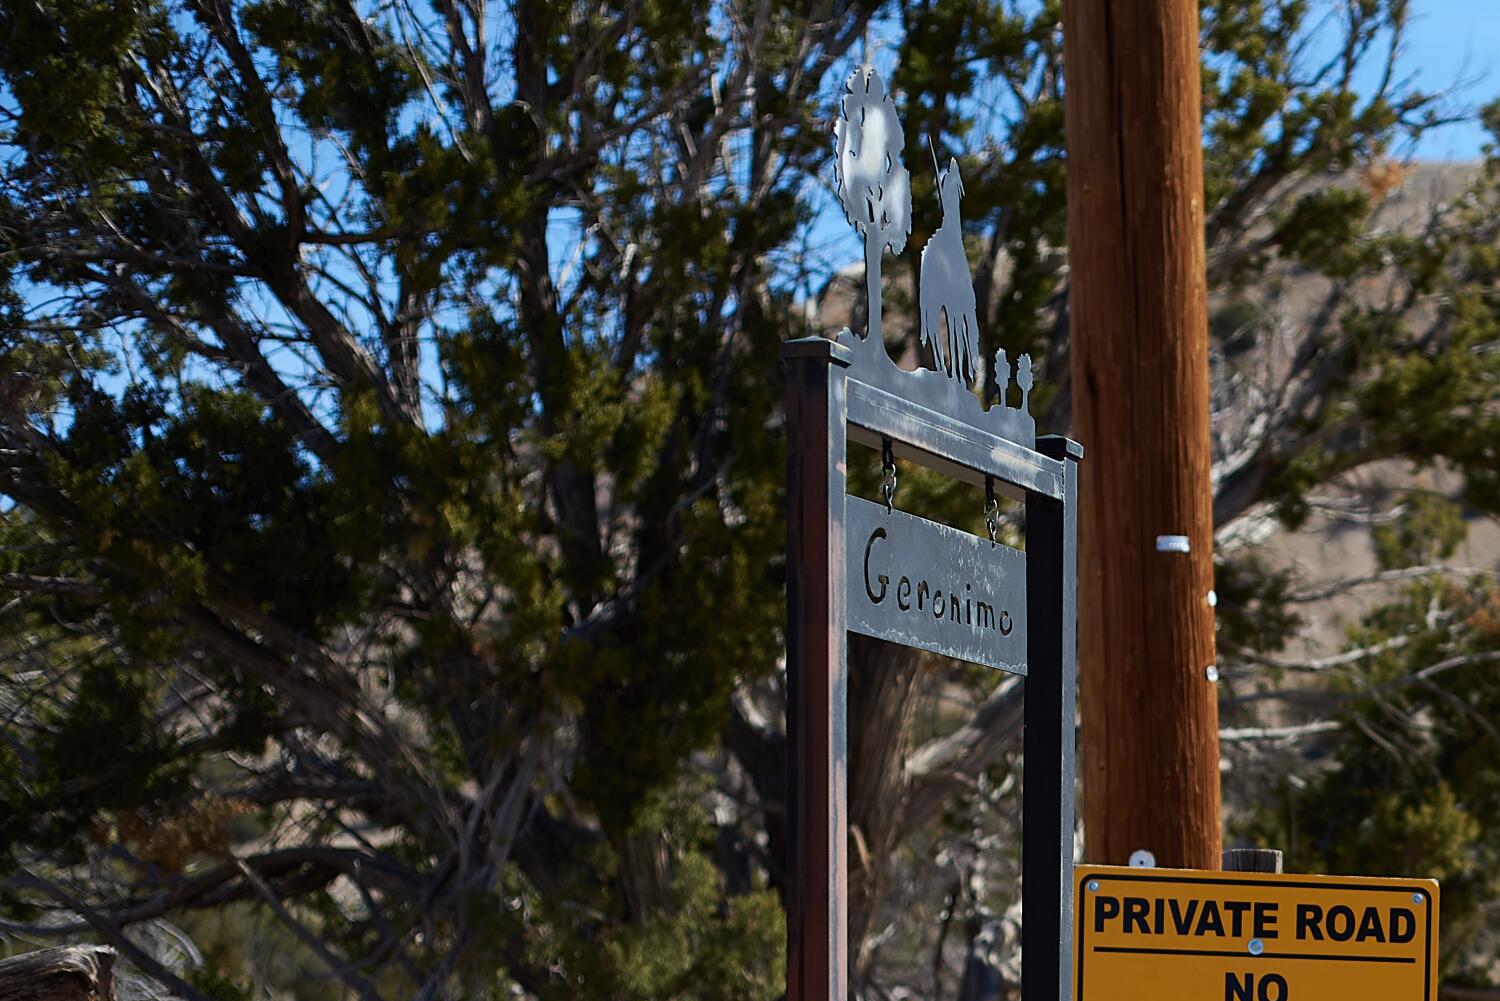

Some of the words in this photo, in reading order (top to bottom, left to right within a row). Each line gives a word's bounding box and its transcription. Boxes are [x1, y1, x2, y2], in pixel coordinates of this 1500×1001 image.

[863, 527, 1013, 636] Geronimo
[1094, 896, 1279, 939] PRIVATE
[1296, 903, 1416, 943] ROAD
